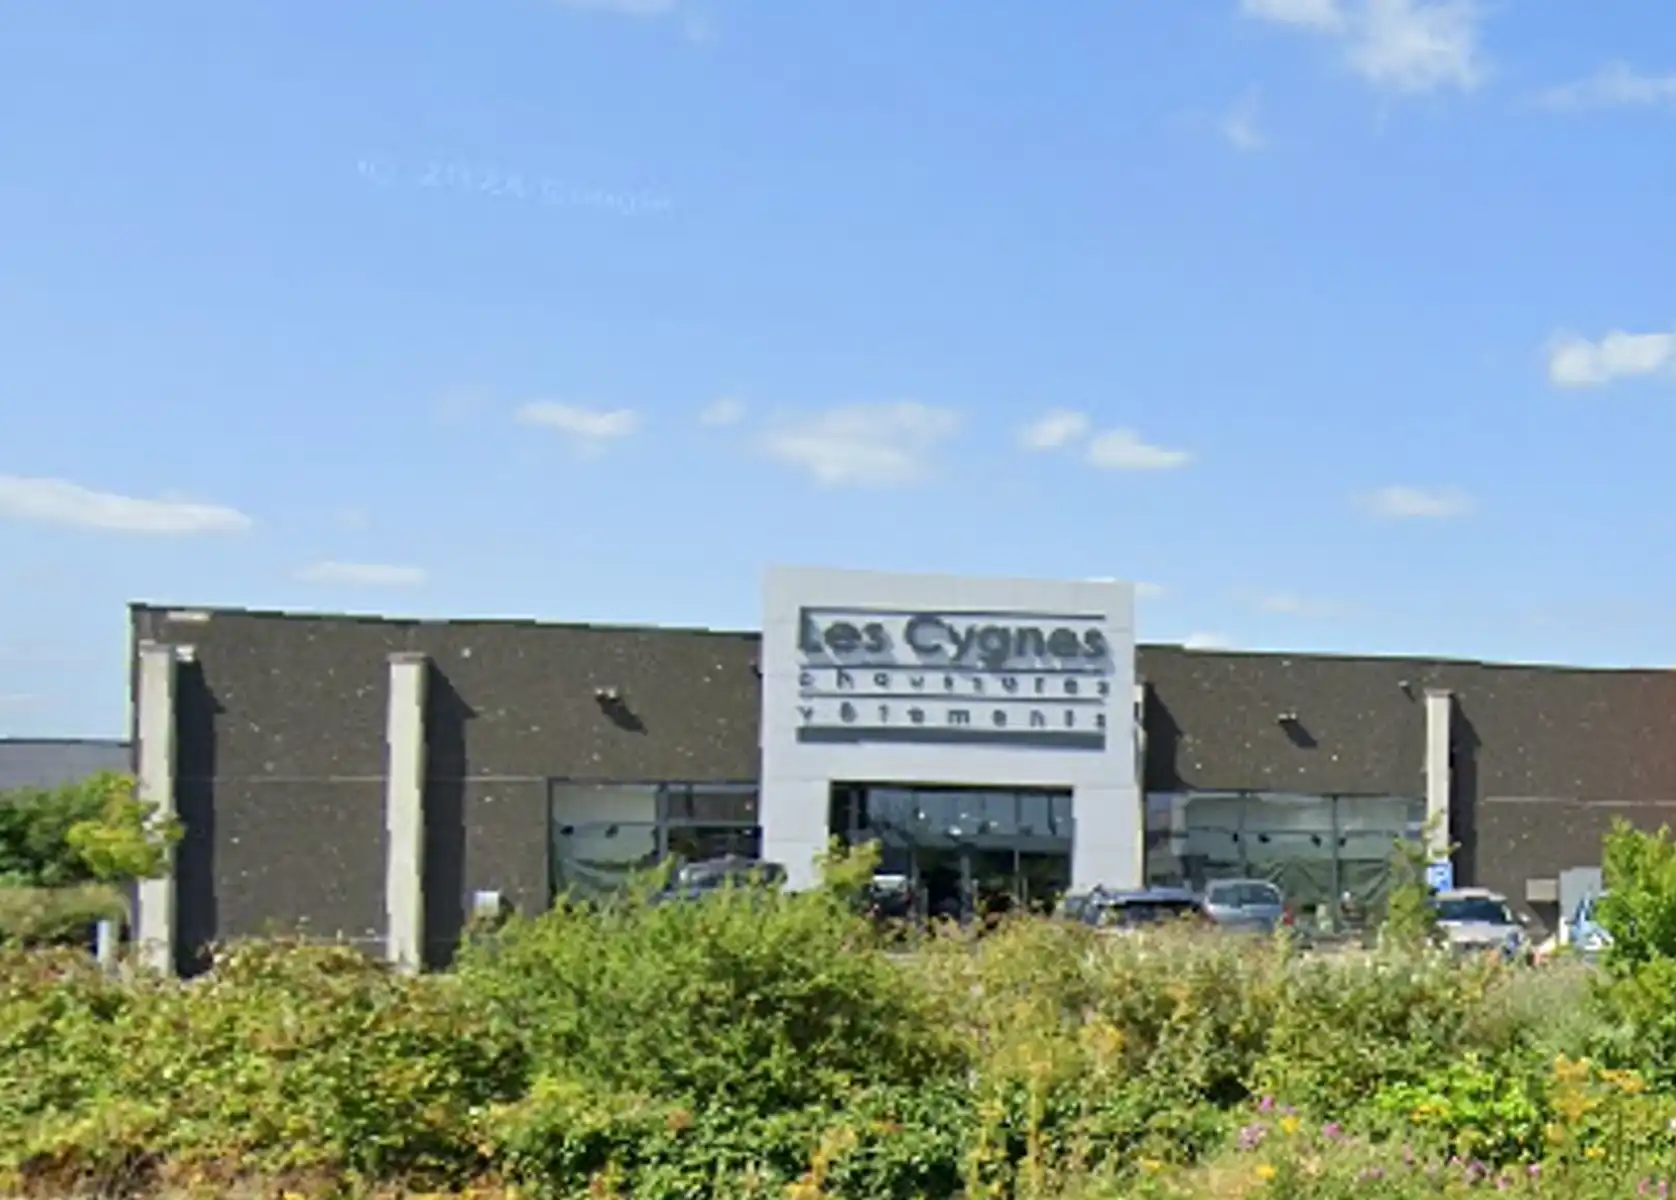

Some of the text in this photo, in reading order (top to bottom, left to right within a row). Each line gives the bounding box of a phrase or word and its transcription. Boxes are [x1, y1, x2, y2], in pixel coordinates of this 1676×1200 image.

[800, 608, 1108, 669] Les Cygnes
[798, 667, 1110, 697] chaussures
[796, 700, 1108, 729] vêtements
